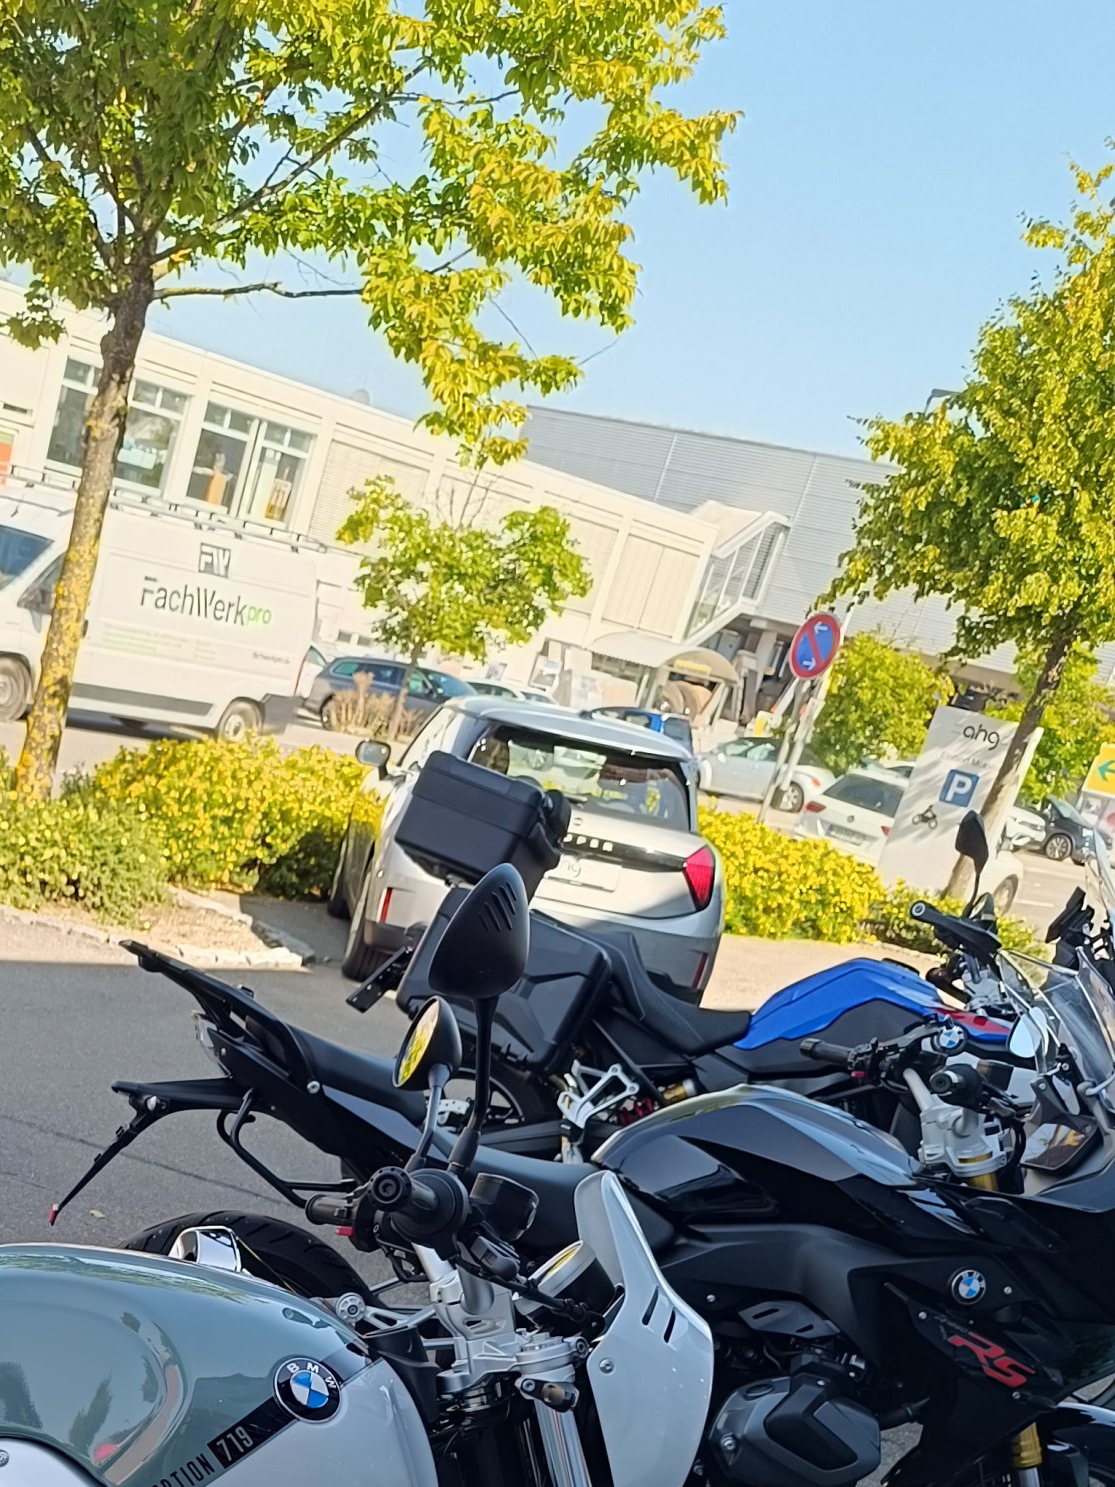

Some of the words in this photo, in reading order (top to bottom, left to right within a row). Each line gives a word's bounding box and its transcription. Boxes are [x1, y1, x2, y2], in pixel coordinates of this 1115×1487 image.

[963, 724, 1000, 751] ahg
[945, 773, 973, 802] P
[947, 1331, 1036, 1388] RS
[286, 1362, 337, 1389] BMW
[216, 1426, 254, 1462] 719
